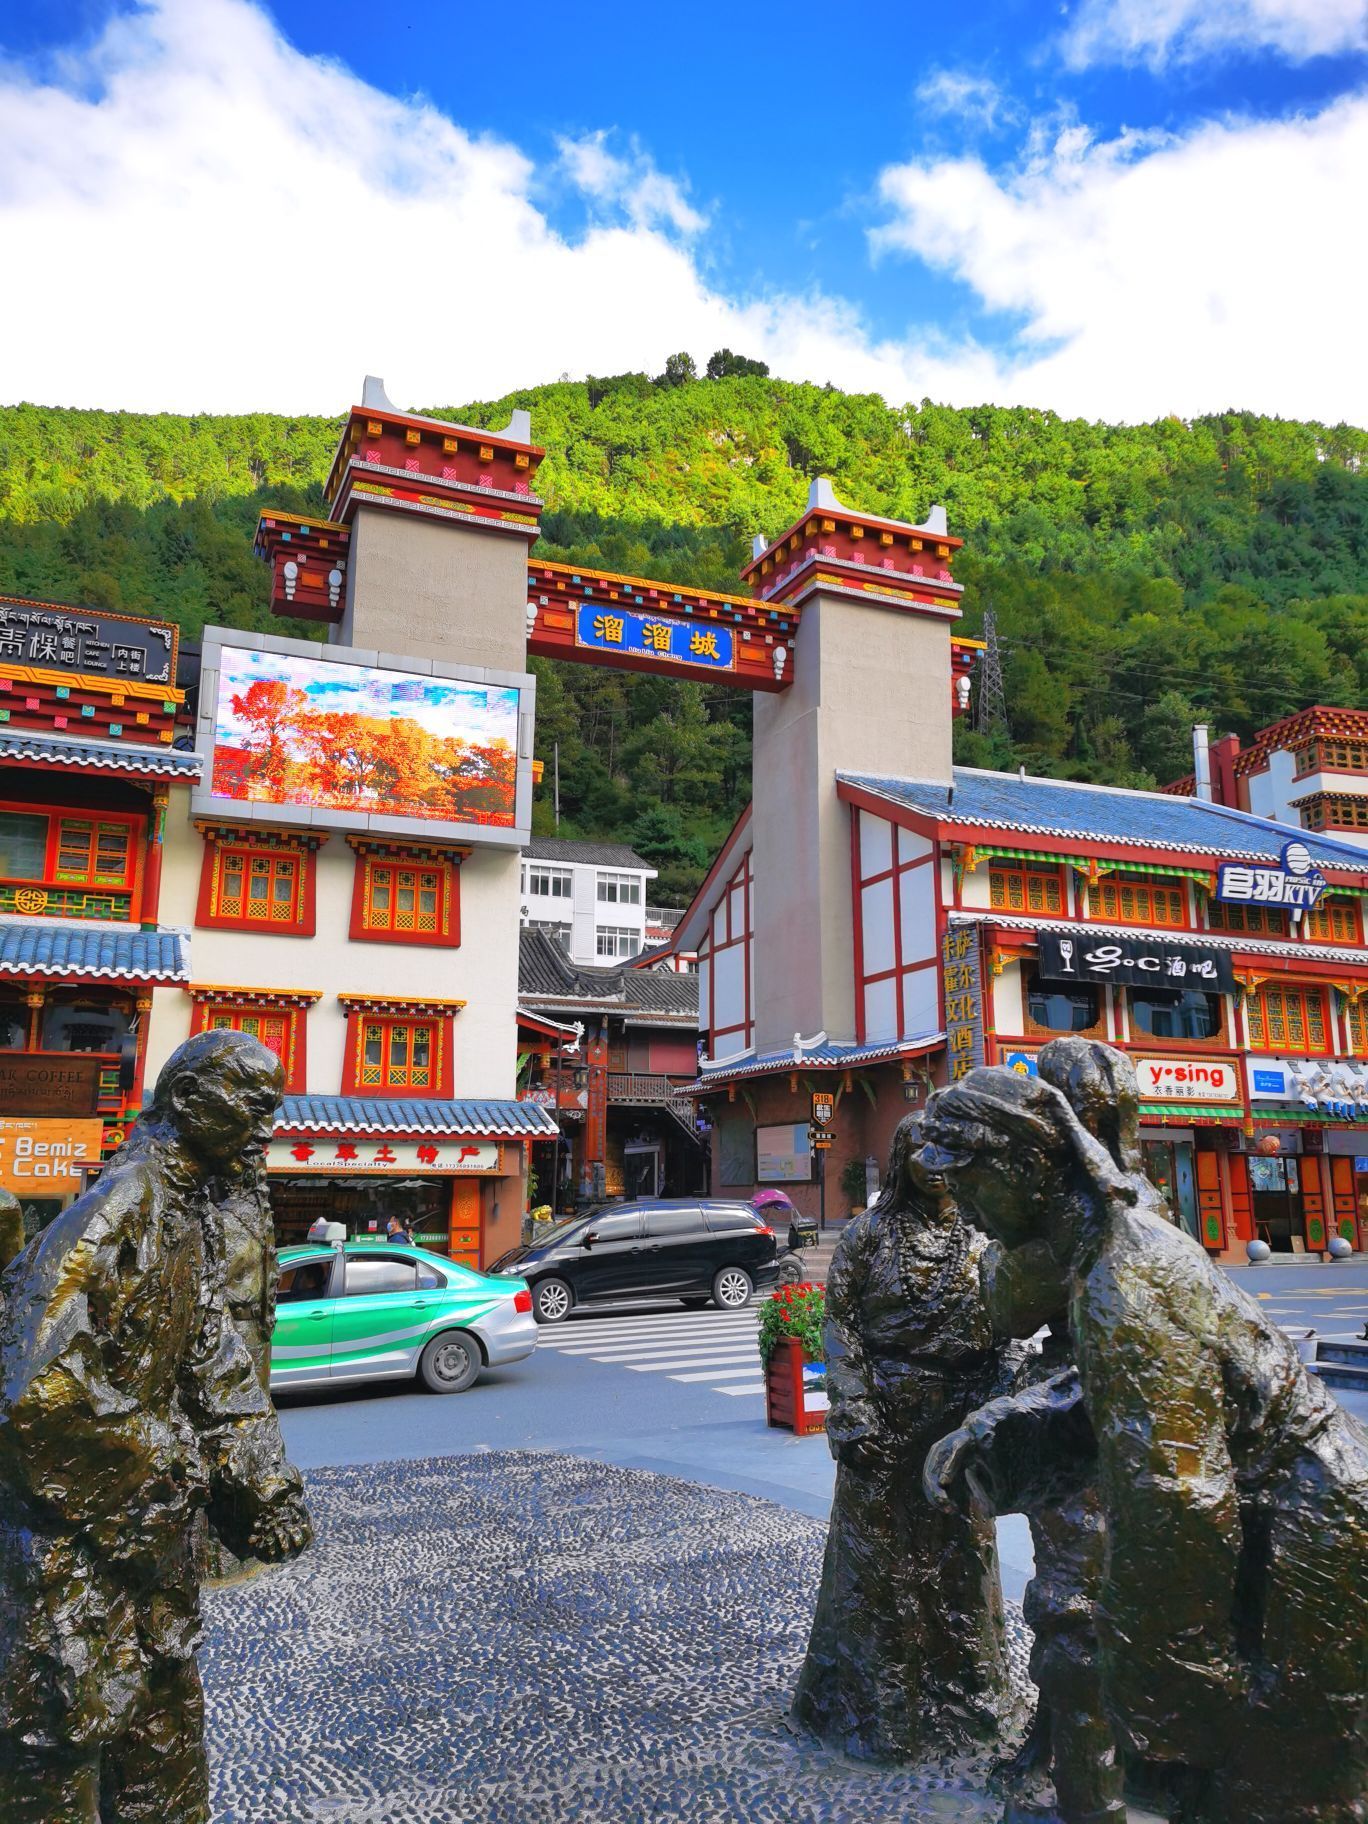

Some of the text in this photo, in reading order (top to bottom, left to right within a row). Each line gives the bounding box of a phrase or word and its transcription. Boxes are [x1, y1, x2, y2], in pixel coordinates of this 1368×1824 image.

[86, 640, 110, 648] KITCHEN
[593, 615, 720, 660] 溜溜城
[61, 637, 76, 663] 餐吧
[84, 660, 107, 668] LOUNGE
[1282, 884, 1321, 905] KTV
[1165, 956, 1217, 979] 酒吧
[27, 1069, 83, 1083] COFFEE
[15, 1137, 87, 1157] Bemiz
